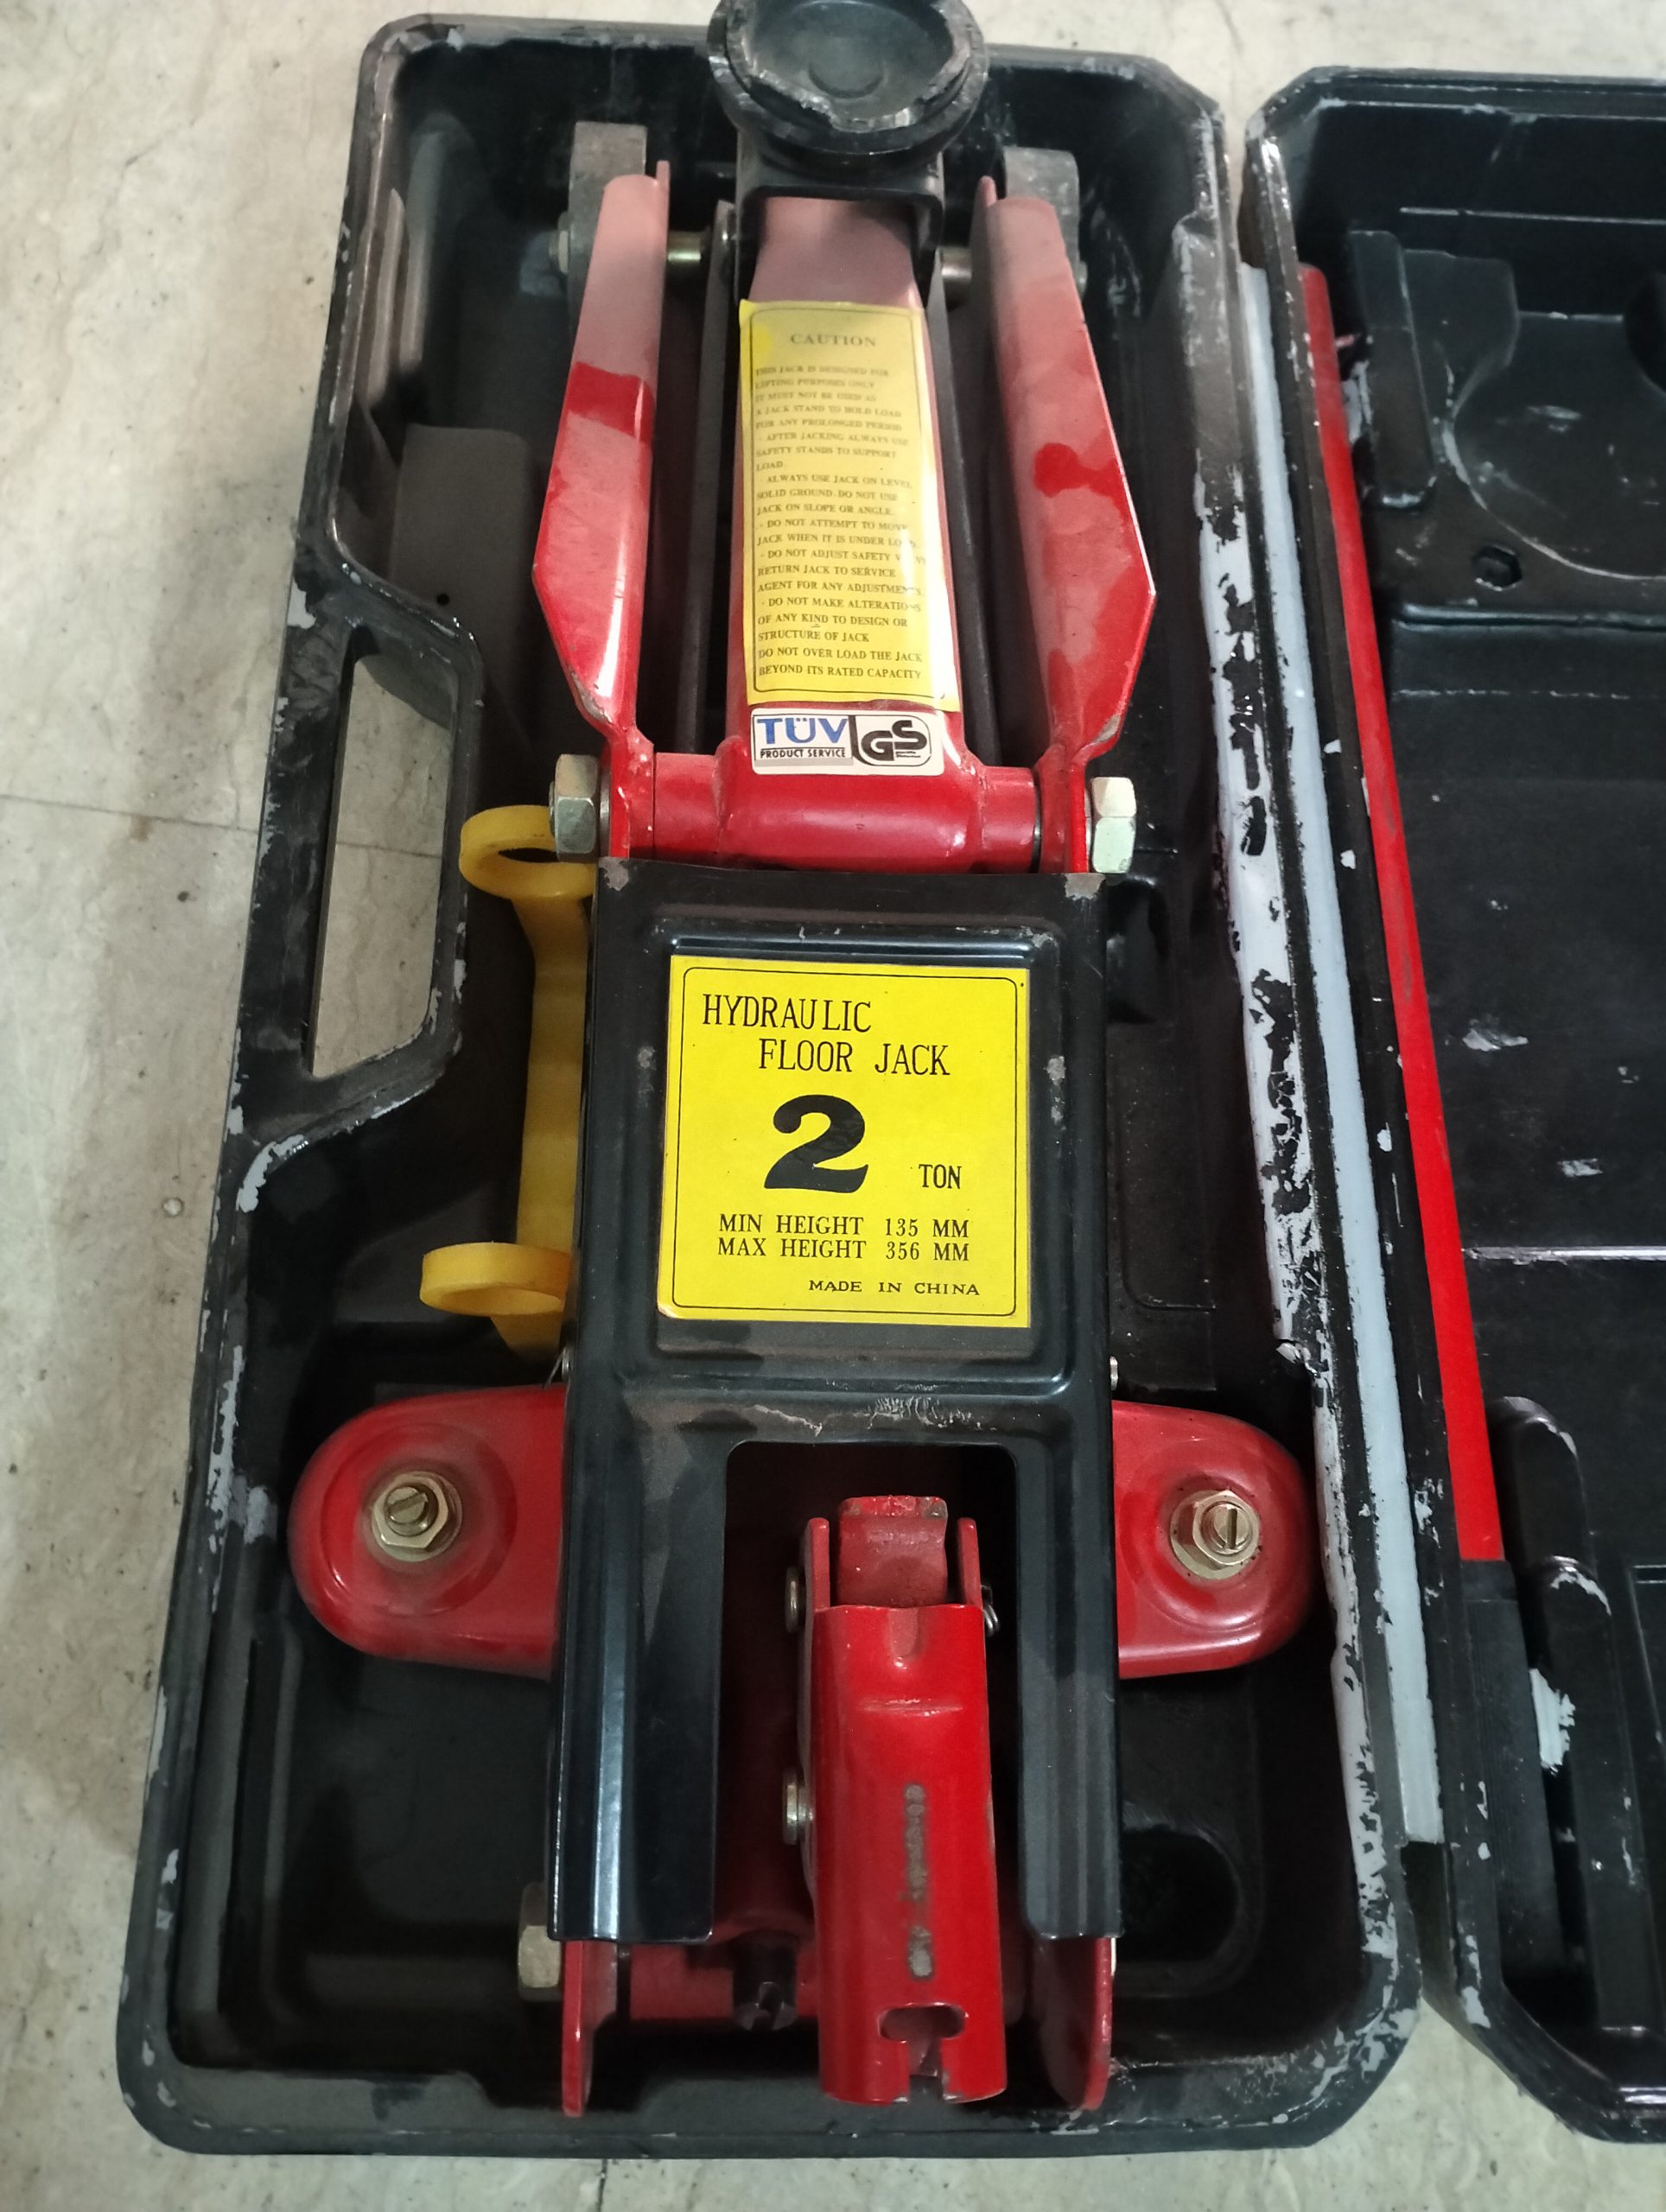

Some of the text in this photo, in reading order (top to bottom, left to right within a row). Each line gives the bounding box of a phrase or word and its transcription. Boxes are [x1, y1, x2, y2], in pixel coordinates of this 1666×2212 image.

[791, 334, 876, 346] CAUTION
[765, 405, 789, 415] JACK
[875, 408, 901, 417] LOAD
[756, 420, 774, 429] FOR
[802, 419, 863, 429] PROLONGED
[766, 432, 797, 442] AFTER
[801, 432, 843, 441] JACKING
[849, 435, 889, 444] ALWAYS
[756, 447, 792, 457] SAFETY
[853, 448, 896, 458] SUPPORT
[756, 461, 783, 471] LOAD
[766, 474, 808, 484] ALWAYS
[811, 474, 830, 483] USE
[833, 475, 859, 484] JACK
[757, 489, 786, 500] SOLID
[856, 492, 874, 500] NOT
[880, 493, 898, 501] USE
[757, 504, 782, 516] JACK
[804, 504, 836, 512] SLOPE
[839, 505, 854, 513] OR
[767, 519, 781, 528] DO
[810, 519, 857, 529] ATTEMPT
[757, 534, 783, 546] JACK
[822, 534, 831, 543] IT
[836, 535, 846, 543] IS
[849, 536, 884, 546] UNDER
[767, 550, 782, 559] DO
[811, 550, 849, 559] ADJUST
[852, 551, 890, 562] SAFETY
[757, 565, 897, 577] RETURN JACK TO SERVICE
[757, 581, 793, 592] AGENT
[797, 581, 817, 589] FOR
[822, 582, 843, 591] ANY
[768, 598, 783, 607] DO
[787, 597, 809, 606] NOT
[812, 598, 844, 607] MAKE
[758, 613, 908, 627] OF ANY KIND TO DESIGN OR
[757, 630, 870, 643] STRUCTURE OF JACK
[759, 647, 923, 662] DO NOT OVER LOAD THE JACK
[759, 664, 921, 679] BEYOND ITS RATED CAPACITY
[756, 717, 848, 745] TÜV
[861, 720, 927, 761] GS
[760, 748, 846, 759] PRODUCT SERVICE
[703, 994, 872, 1033] HYDRAULIC
[759, 1038, 951, 1076] FLOOR JACK
[764, 1094, 963, 1193] 2 TON
[719, 1213, 970, 1238] MIN HEIGHT 135 MM
[717, 1237, 970, 1262] MAX HEIGHT 356 MM
[808, 1280, 980, 1296] MADE IN CHINA
